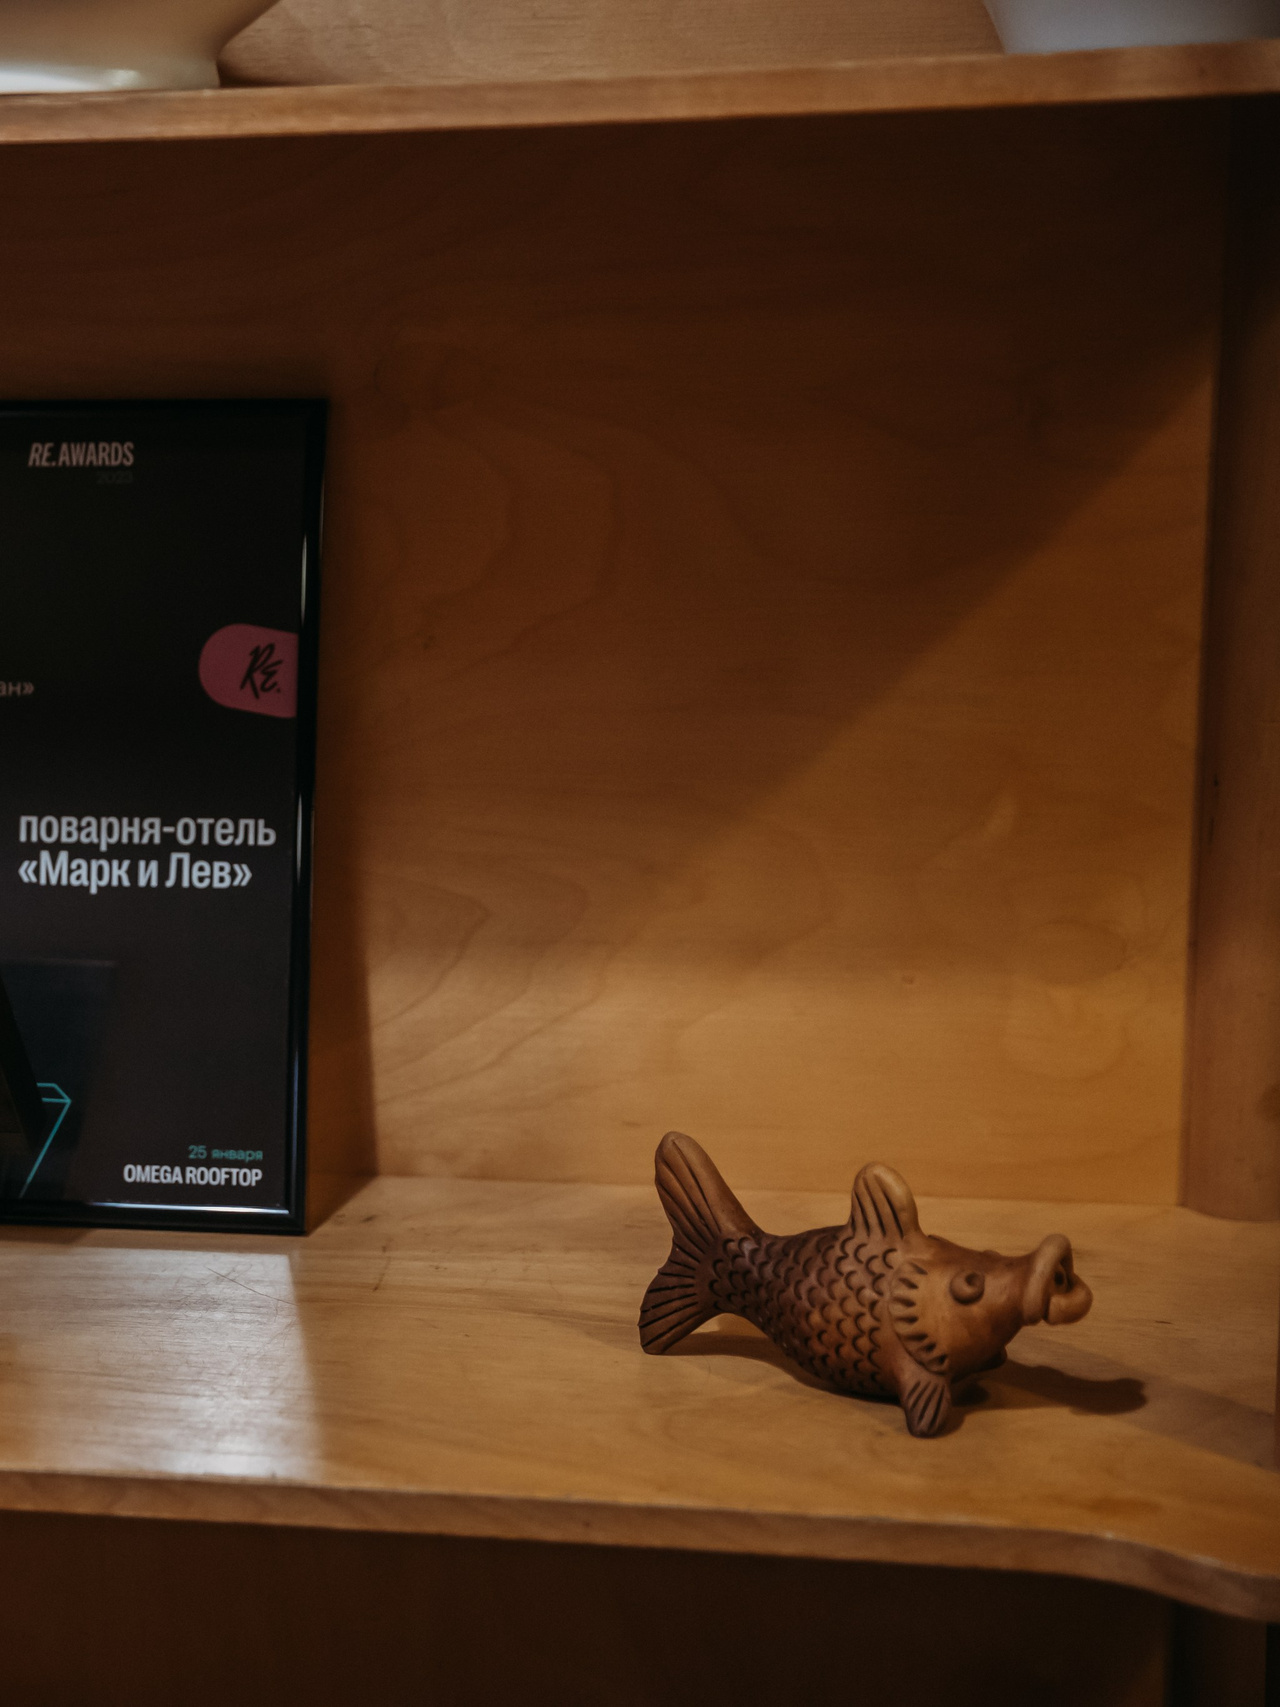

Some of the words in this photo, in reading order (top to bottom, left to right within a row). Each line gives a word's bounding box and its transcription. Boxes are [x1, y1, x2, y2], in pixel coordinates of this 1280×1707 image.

[27, 441, 135, 468] RE.AWARDS
[19, 815, 277, 852] поварня-отель
[18, 850, 131, 895] «Марк
[137, 860, 159, 888] и
[164, 852, 253, 889] Лев»
[188, 1145, 207, 1160] 25
[211, 1149, 264, 1163] января
[123, 1164, 183, 1184] OMEGA
[185, 1166, 263, 1187] ROOFTOP
